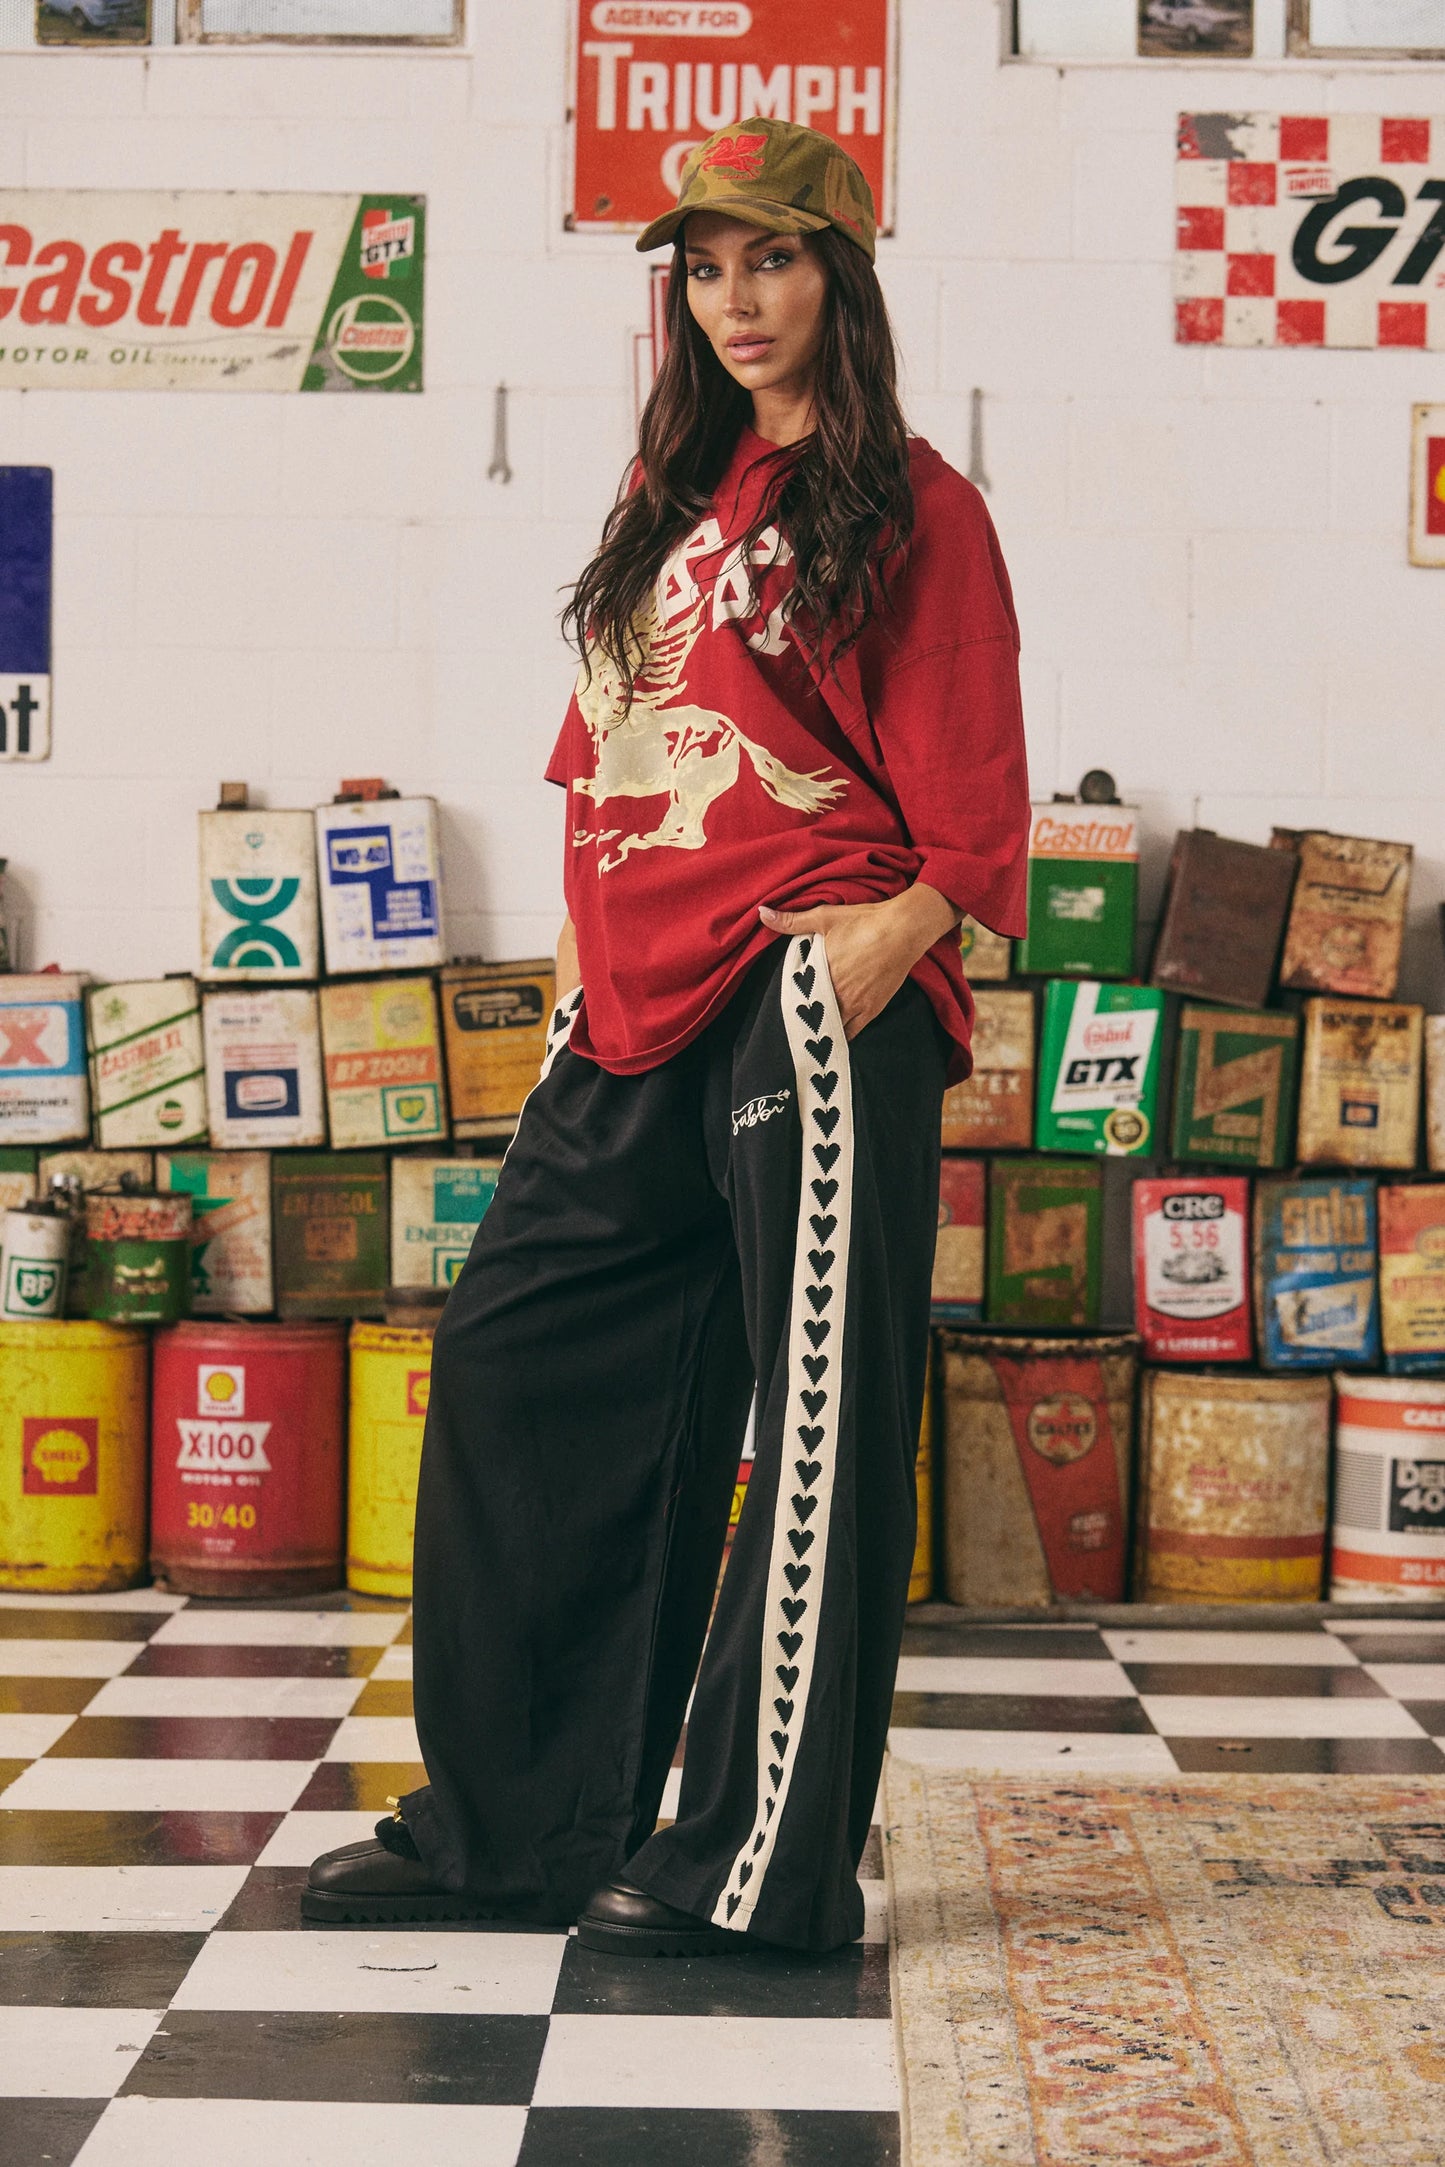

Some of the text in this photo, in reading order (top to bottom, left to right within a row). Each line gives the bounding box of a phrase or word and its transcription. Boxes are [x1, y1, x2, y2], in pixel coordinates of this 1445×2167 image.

[604, 8, 739, 28] AGENCY FOR
[582, 41, 882, 135] TRIUMPH
[366, 239, 407, 264] GTX
[110, 348, 155, 364] OIL
[1033, 817, 1133, 850] Castrol
[1065, 1056, 1141, 1085] GTX
[1164, 1195, 1224, 1220] CRC
[20, 1272, 55, 1300] BP
[41, 1450, 82, 1463] SHELL
[181, 1473, 261, 1487] MOTOR OIL
[187, 1502, 256, 1530] 30/40
